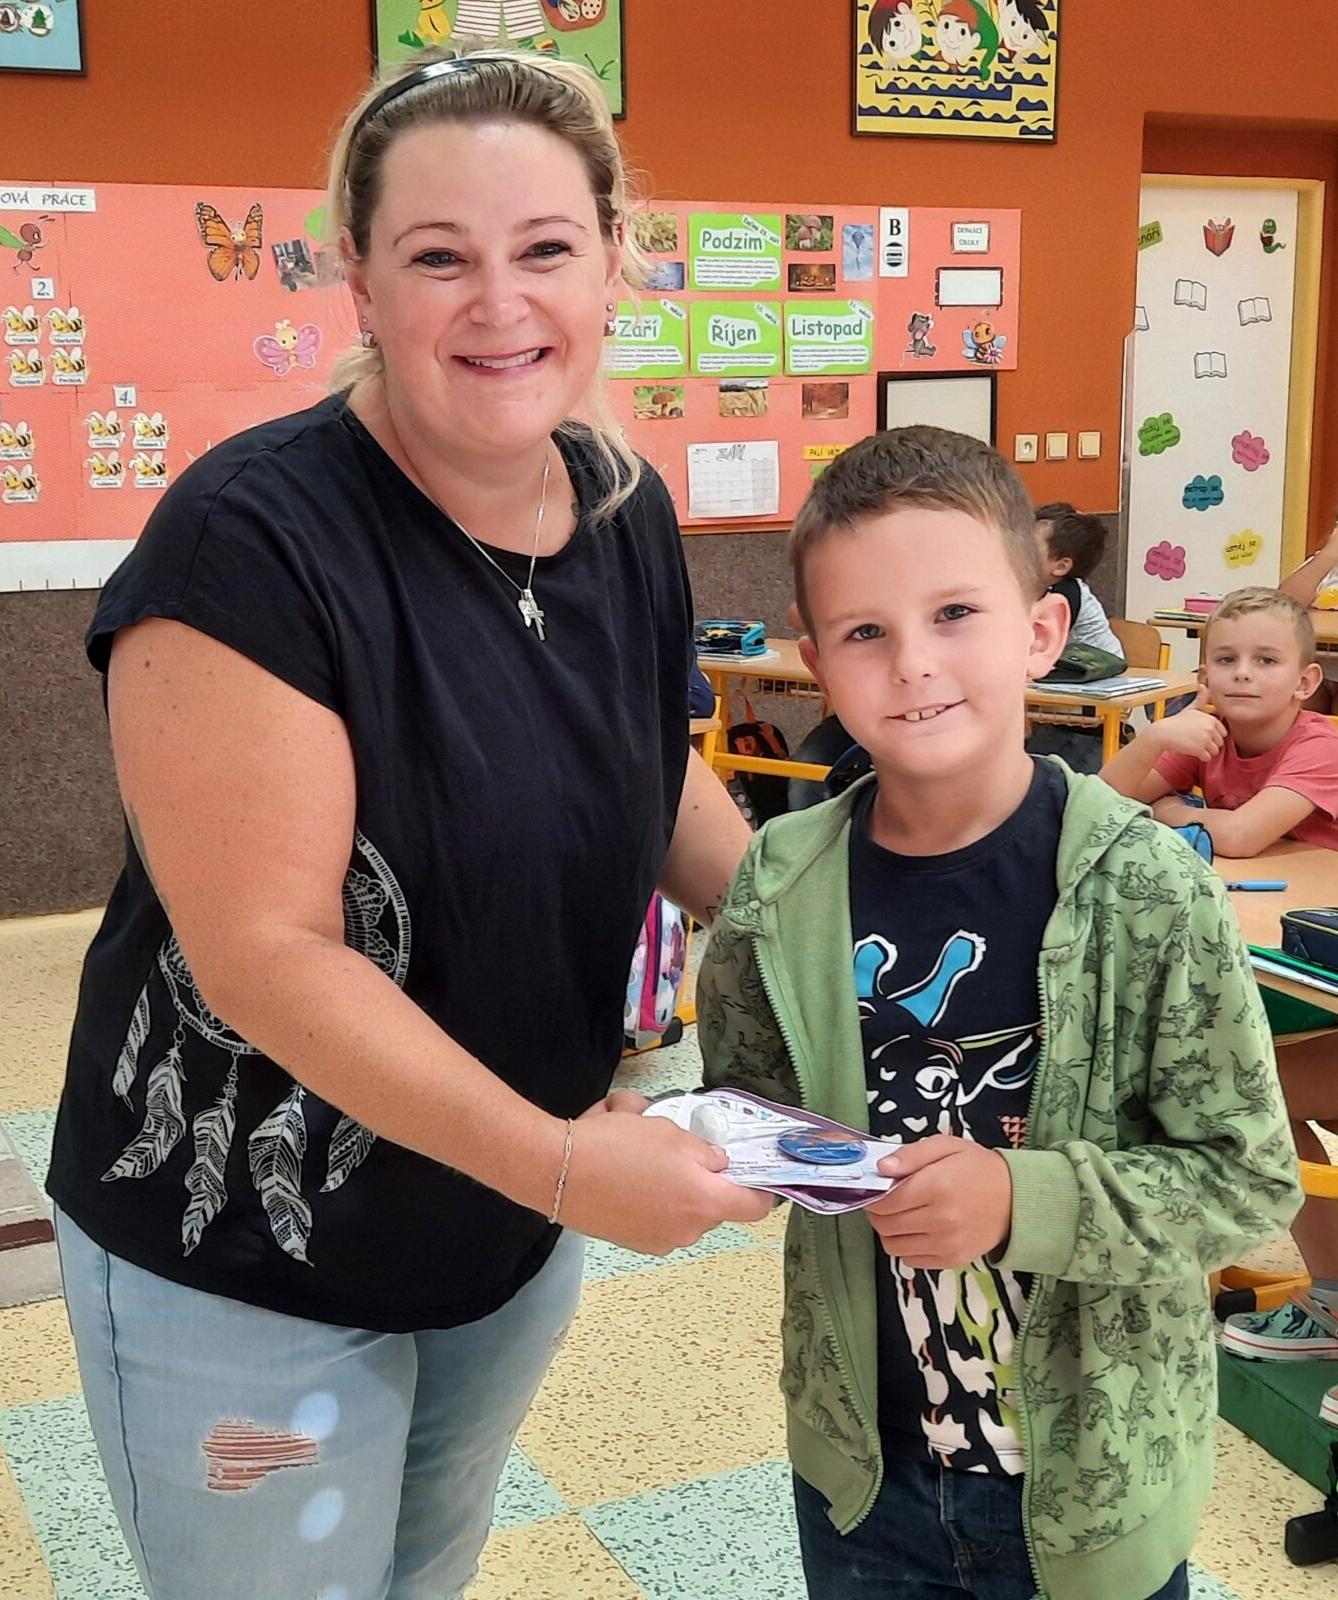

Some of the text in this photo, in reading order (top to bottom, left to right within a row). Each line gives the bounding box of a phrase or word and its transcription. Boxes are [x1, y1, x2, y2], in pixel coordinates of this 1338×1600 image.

[42, 192, 87, 206] PRÁCE
[889, 218, 902, 236] B
[702, 230, 763, 250] Podzim
[37, 281, 51, 297] 2.
[712, 319, 757, 347] Říjen
[792, 318, 862, 341] Listopad
[119, 390, 133, 405] 4.
